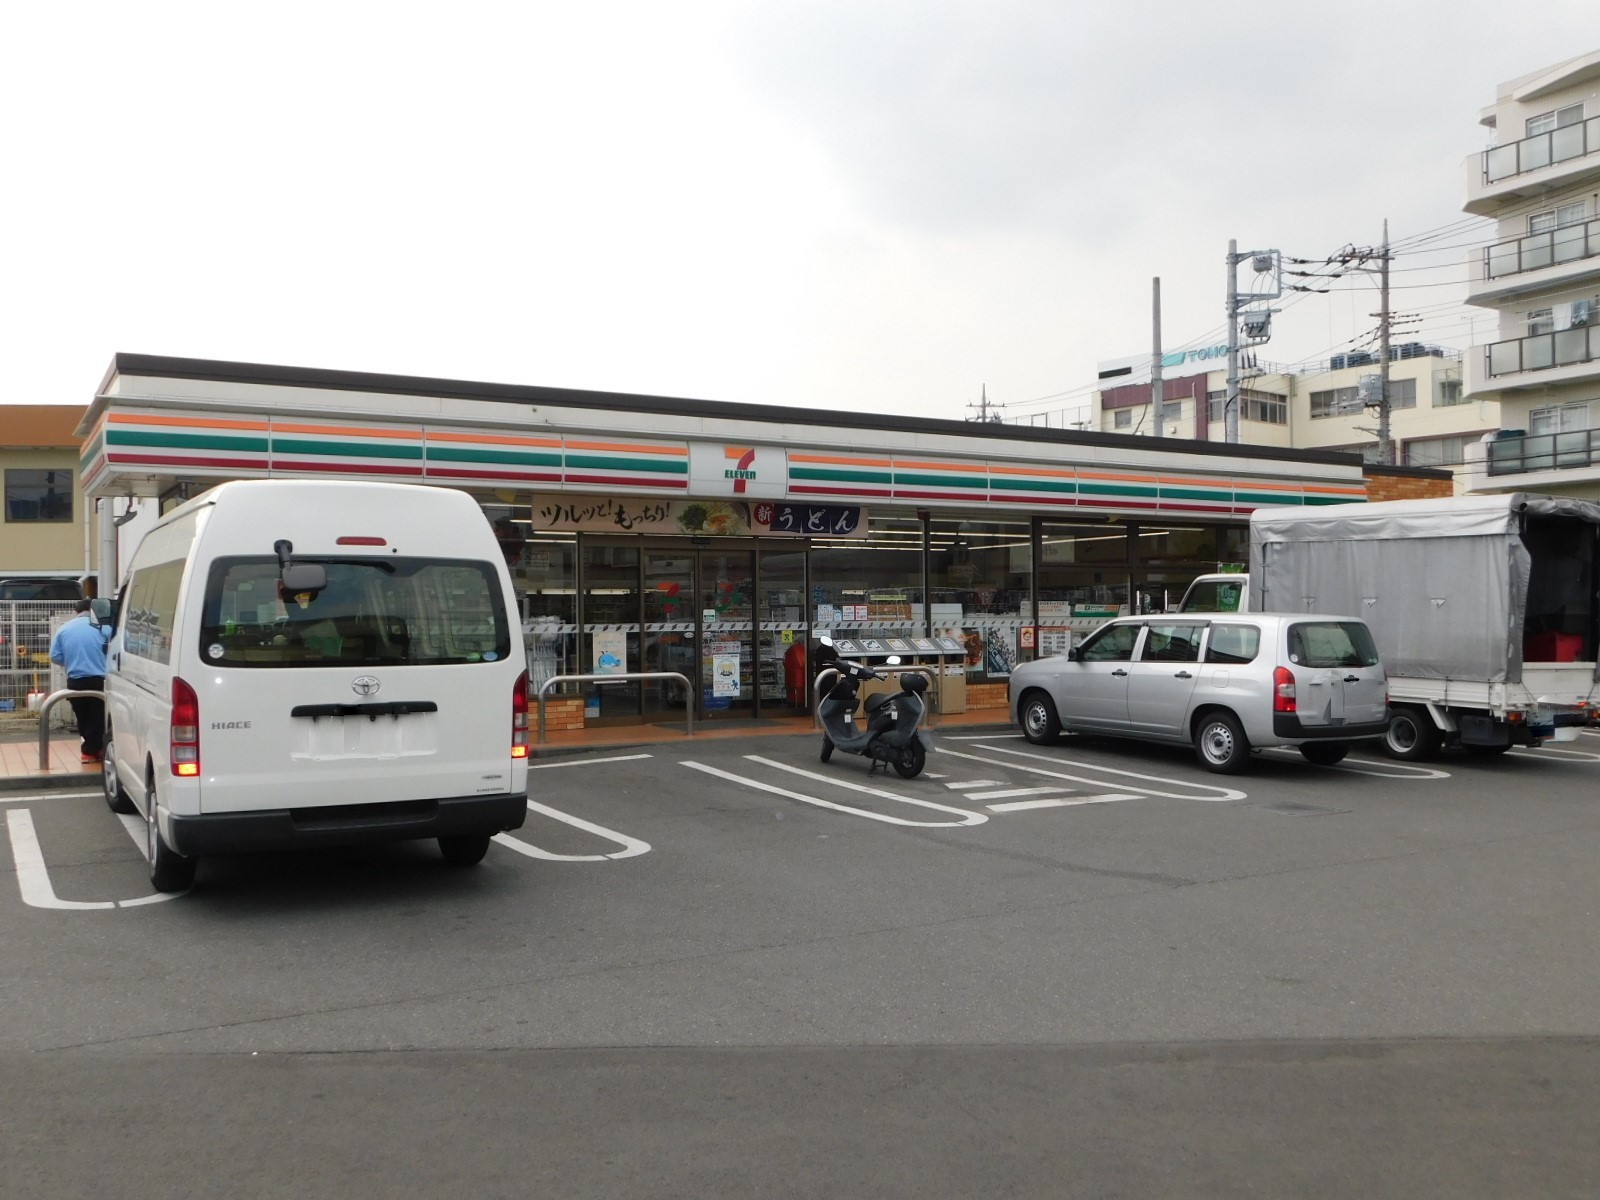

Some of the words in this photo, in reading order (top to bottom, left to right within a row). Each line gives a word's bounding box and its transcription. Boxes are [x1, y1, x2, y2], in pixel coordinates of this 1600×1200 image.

[725, 447, 755, 493] 7
[758, 506, 772, 522] 新
[779, 507, 855, 531] うどん
[211, 721, 251, 730] HIACE
